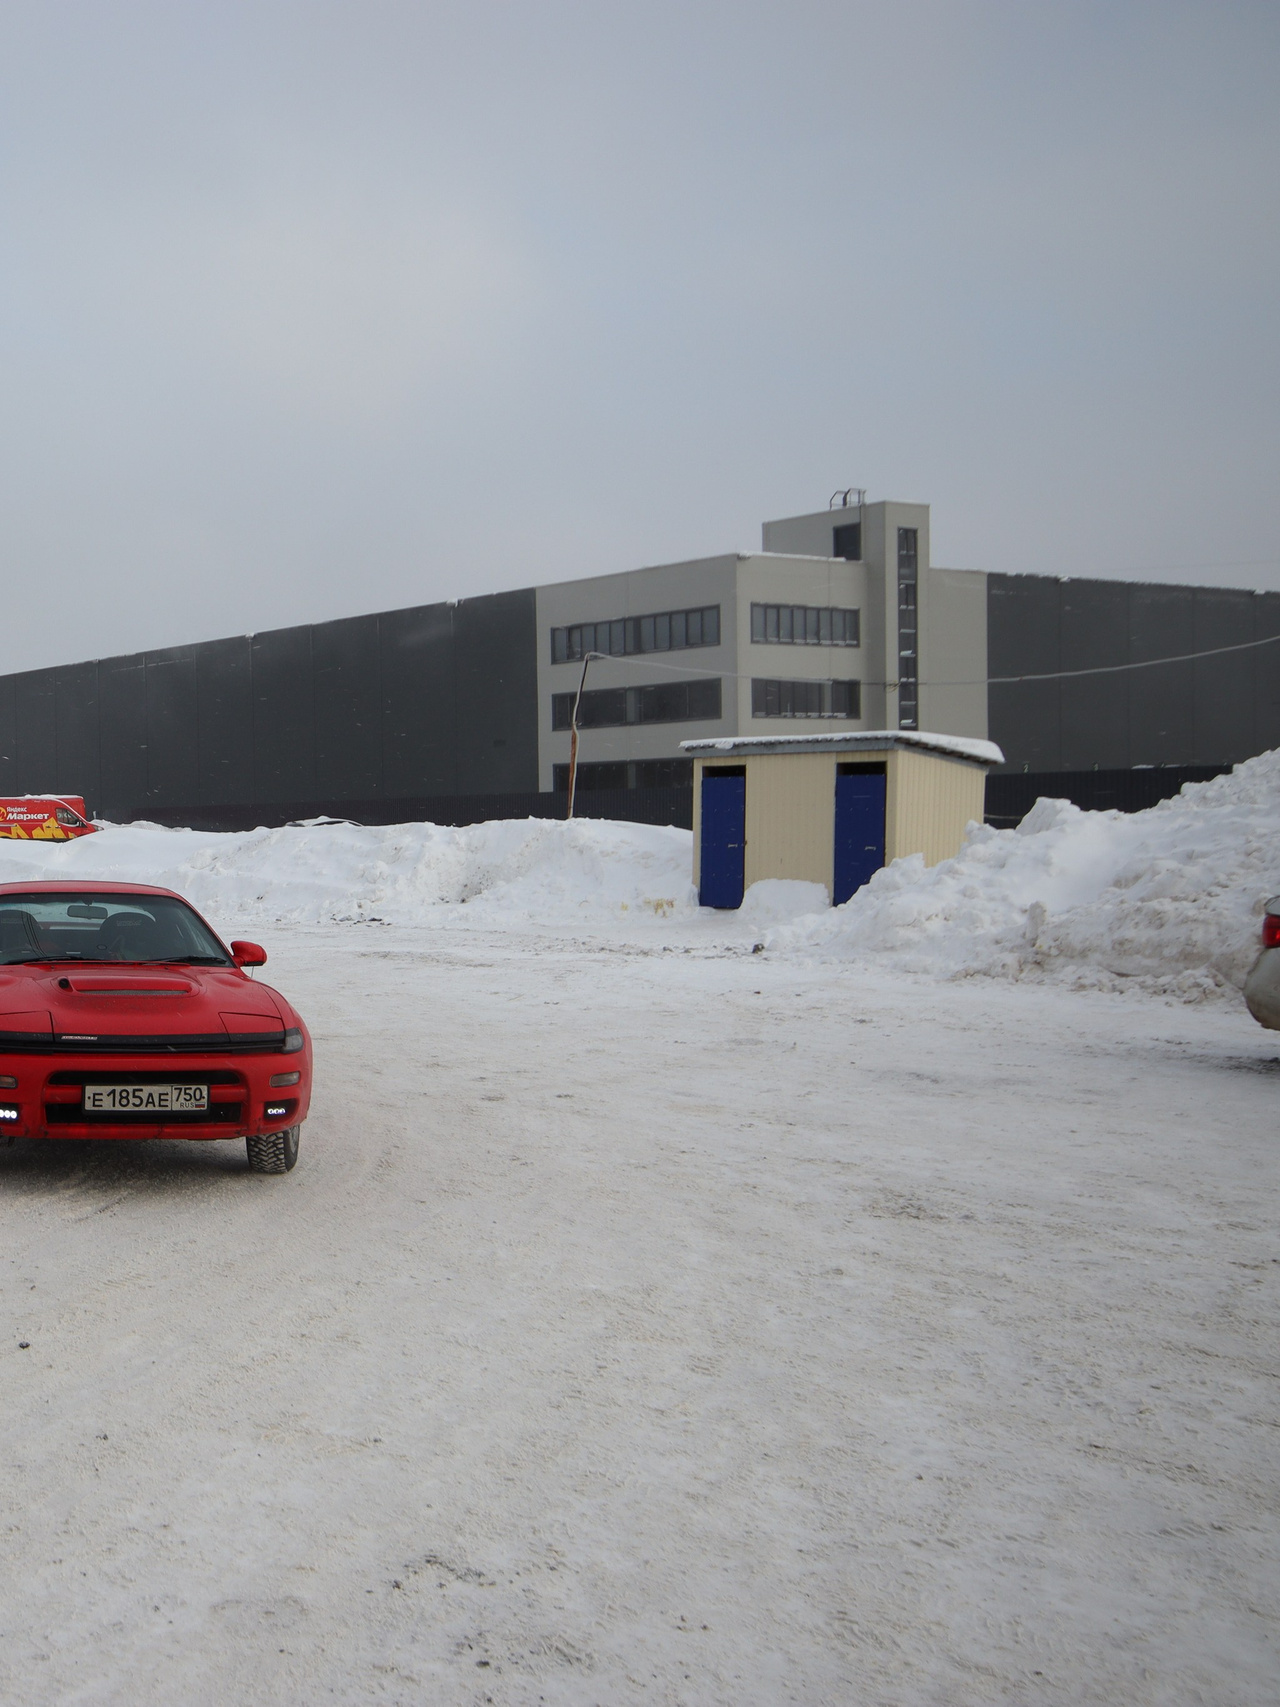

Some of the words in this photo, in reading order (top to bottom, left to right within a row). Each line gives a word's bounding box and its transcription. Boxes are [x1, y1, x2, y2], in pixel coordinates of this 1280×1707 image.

[6, 806, 28, 814] Яндекс
[6, 812, 51, 822] Маркет
[173, 1087, 203, 1102] 750
